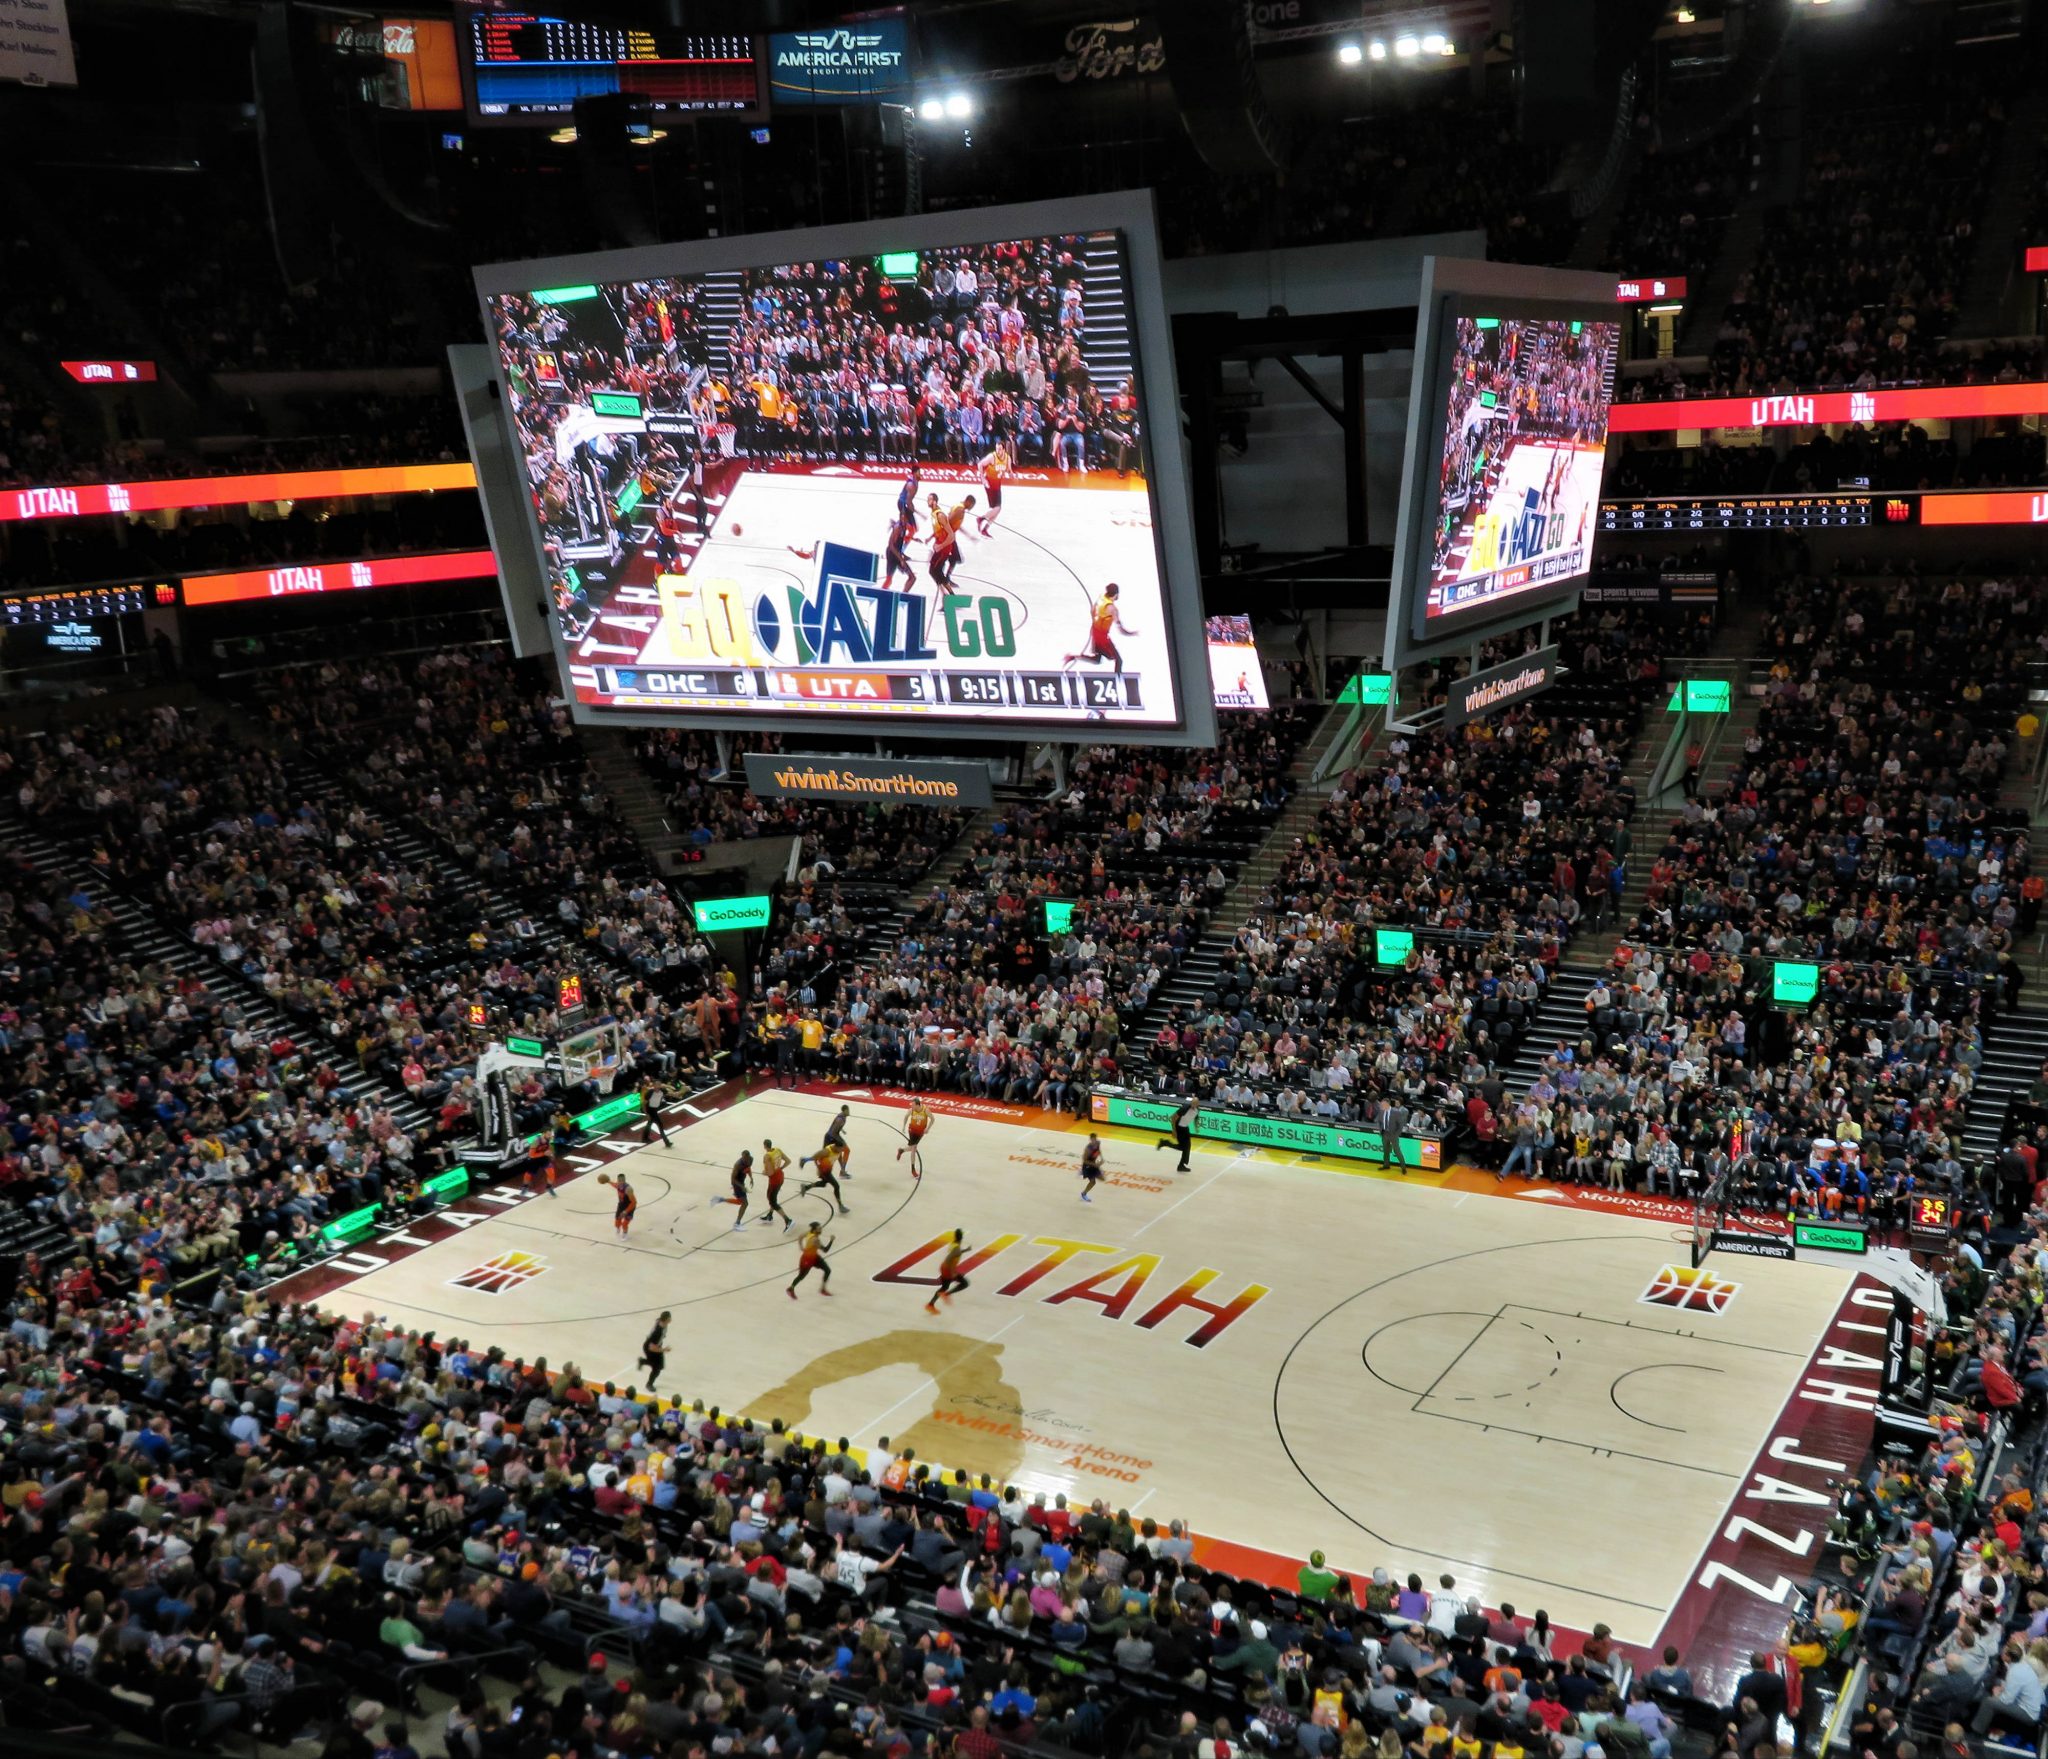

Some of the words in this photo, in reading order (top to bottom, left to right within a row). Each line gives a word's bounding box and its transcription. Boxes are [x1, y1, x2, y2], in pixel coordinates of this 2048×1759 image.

[777, 52, 852, 66] AMERICA
[854, 52, 901, 66] FIRST
[1056, 18, 1166, 83] Ford
[1617, 283, 1640, 298] TAH
[82, 363, 113, 380] UTAH
[1752, 395, 1814, 426] UTAH
[18, 487, 78, 518] UTAH
[269, 567, 324, 595] UTAH
[1457, 582, 1478, 598] OKC
[1506, 571, 1524, 584] UTA
[657, 573, 752, 660] GO
[758, 540, 937, 664] JAZZ
[943, 594, 1016, 657] GO
[646, 674, 708, 694] OKC
[734, 675, 746, 694] 6
[811, 678, 877, 698] UTA
[910, 677, 922, 698] 5
[960, 678, 999, 700] 9:15
[1029, 679, 1057, 702] 1st
[1094, 680, 1117, 703] 24
[1466, 667, 1546, 713] vivint.SmartHome
[775, 766, 958, 797] vivint.SmartHome
[709, 907, 765, 921] GoDaddy
[1782, 978, 1815, 988] GoDaddy
[561, 988, 580, 1007] 24
[880, 1090, 958, 1107] MOUNTAIN
[959, 1102, 1024, 1117] AMERICA
[1008, 1154, 1174, 1186] vivint.SrtHome
[1106, 1178, 1164, 1193] Arena
[1577, 1190, 1688, 1214] MOUNTAIN
[1626, 1206, 1676, 1219] CREDIT
[327, 1185, 537, 1275] UTAH
[1920, 1209, 1942, 1225] 24
[1715, 1241, 1759, 1255] AMERICA
[1760, 1245, 1790, 1258] FIRST
[1809, 1232, 1858, 1248] GoDaddy
[871, 1229, 1273, 1350] UTAH
[932, 1408, 1154, 1470] vivint.SmartHome
[1060, 1454, 1141, 1483] Arena
[1698, 1436, 1847, 1605] JAZZ
